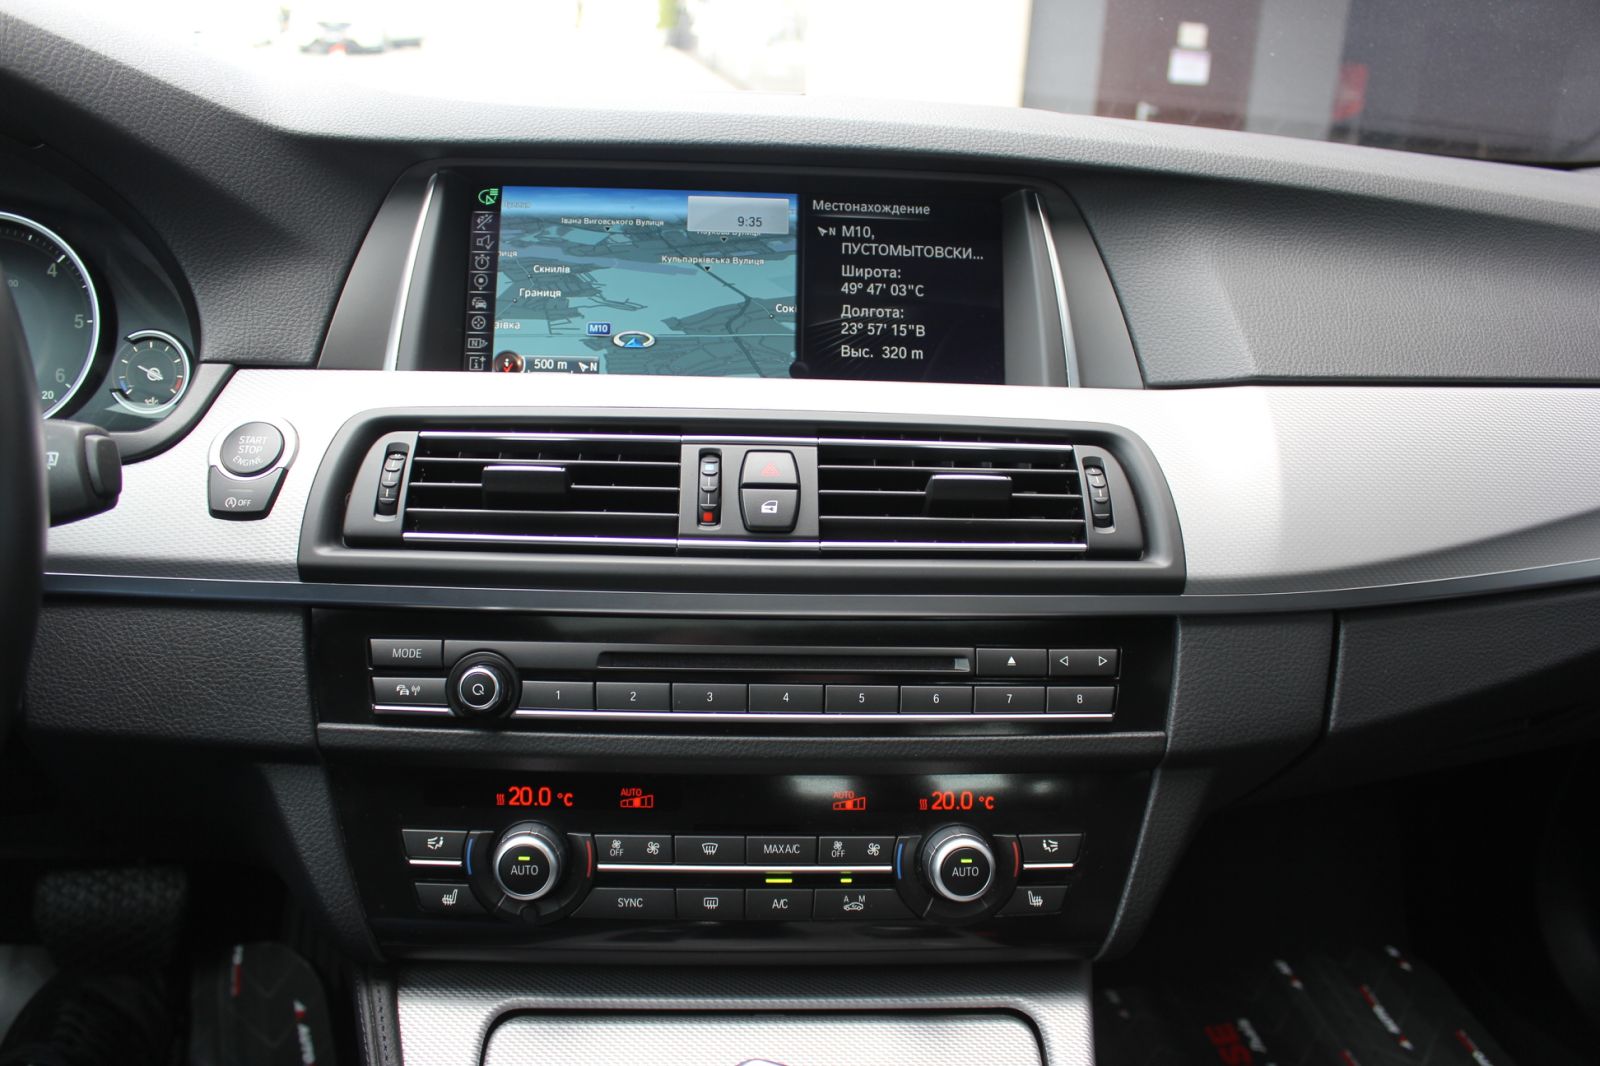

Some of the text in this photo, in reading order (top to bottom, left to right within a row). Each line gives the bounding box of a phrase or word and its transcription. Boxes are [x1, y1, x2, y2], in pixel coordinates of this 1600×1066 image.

[812, 199, 931, 216] Местонахождение
[635, 218, 664, 227] Вулиця
[737, 215, 763, 228] 9:35
[661, 255, 764, 266] Кульпарківська Вулиця
[47, 264, 58, 278] 4
[533, 265, 570, 275] Скнилів
[841, 264, 902, 280] Широта:
[519, 288, 562, 298] Границя
[841, 282, 863, 294] 49°
[840, 304, 904, 319] Долгота:
[74, 314, 84, 329] 5
[589, 324, 608, 334] M10
[841, 322, 863, 335] 23°
[841, 345, 874, 358] Выс.
[882, 346, 907, 359] 320
[533, 358, 568, 370] 500 m
[55, 367, 65, 383] 6
[42, 390, 54, 400] 20
[239, 435, 268, 445] START
[238, 445, 263, 454] STOP
[232, 455, 263, 466] ENGINE
[237, 499, 252, 507] OFF
[392, 648, 422, 659] MODE
[555, 691, 560, 700] 1
[629, 691, 637, 702] 2
[706, 692, 713, 702] 3
[782, 692, 789, 703] 4
[859, 693, 865, 703] 5
[933, 693, 940, 704] 6
[1006, 694, 1013, 704] 7
[1076, 694, 1083, 704] 8
[508, 786, 551, 806] 20.0
[620, 788, 642, 797] AUTO
[833, 790, 855, 799] AUTO
[931, 791, 973, 810] 20.0
[609, 849, 624, 857] OFF
[831, 850, 845, 858] OFF
[510, 864, 538, 876] AUTO
[952, 866, 979, 877] AUTO
[617, 897, 643, 908] SYNC
[772, 898, 788, 909] A/C
